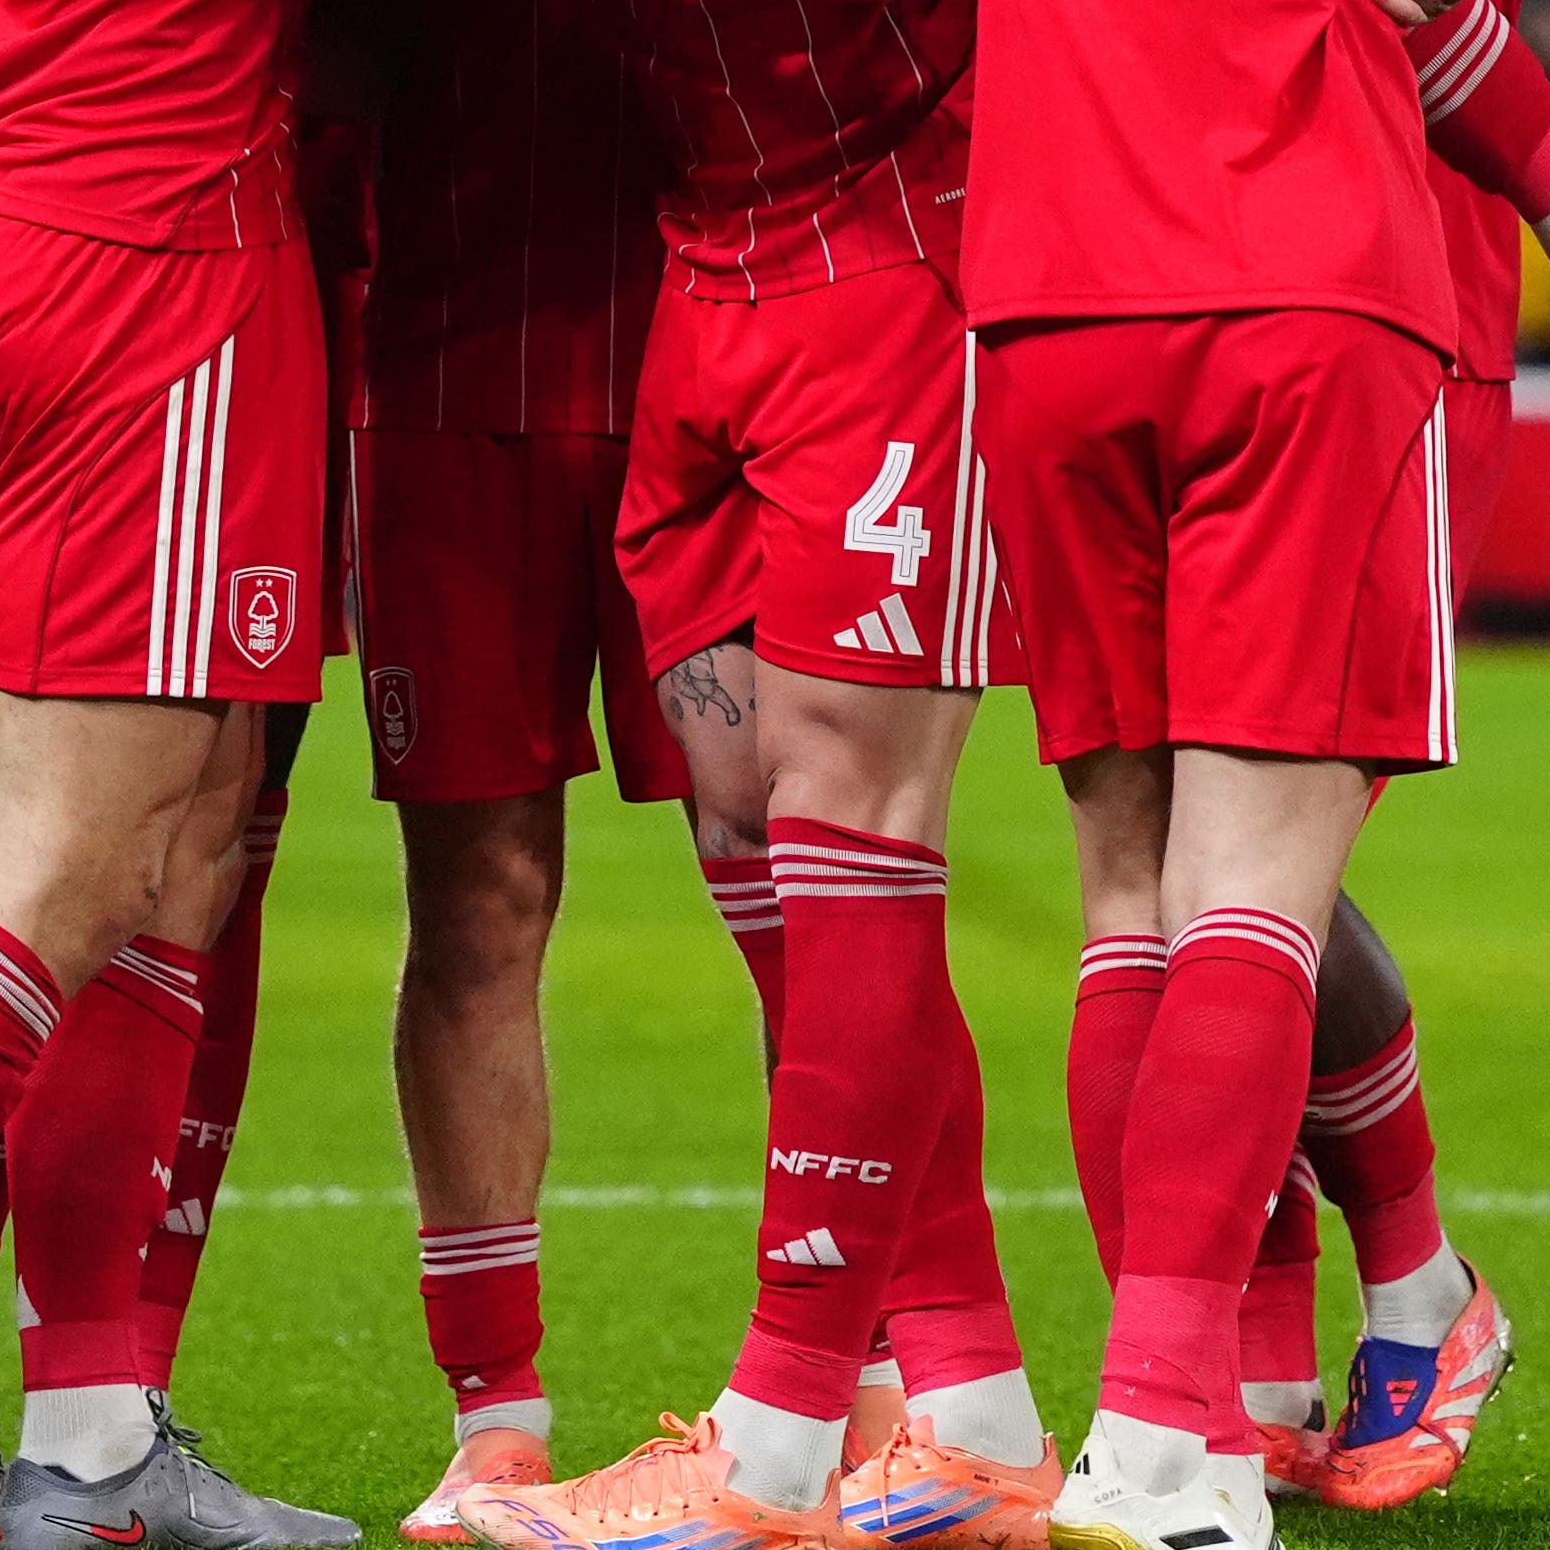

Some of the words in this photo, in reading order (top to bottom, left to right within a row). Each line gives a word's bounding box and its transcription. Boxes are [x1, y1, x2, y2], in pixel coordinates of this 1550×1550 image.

[935, 187, 966, 205] AERORE
[843, 440, 932, 588] 4
[770, 1146, 893, 1185] NFFC
[1093, 1487, 1123, 1504] COPA
